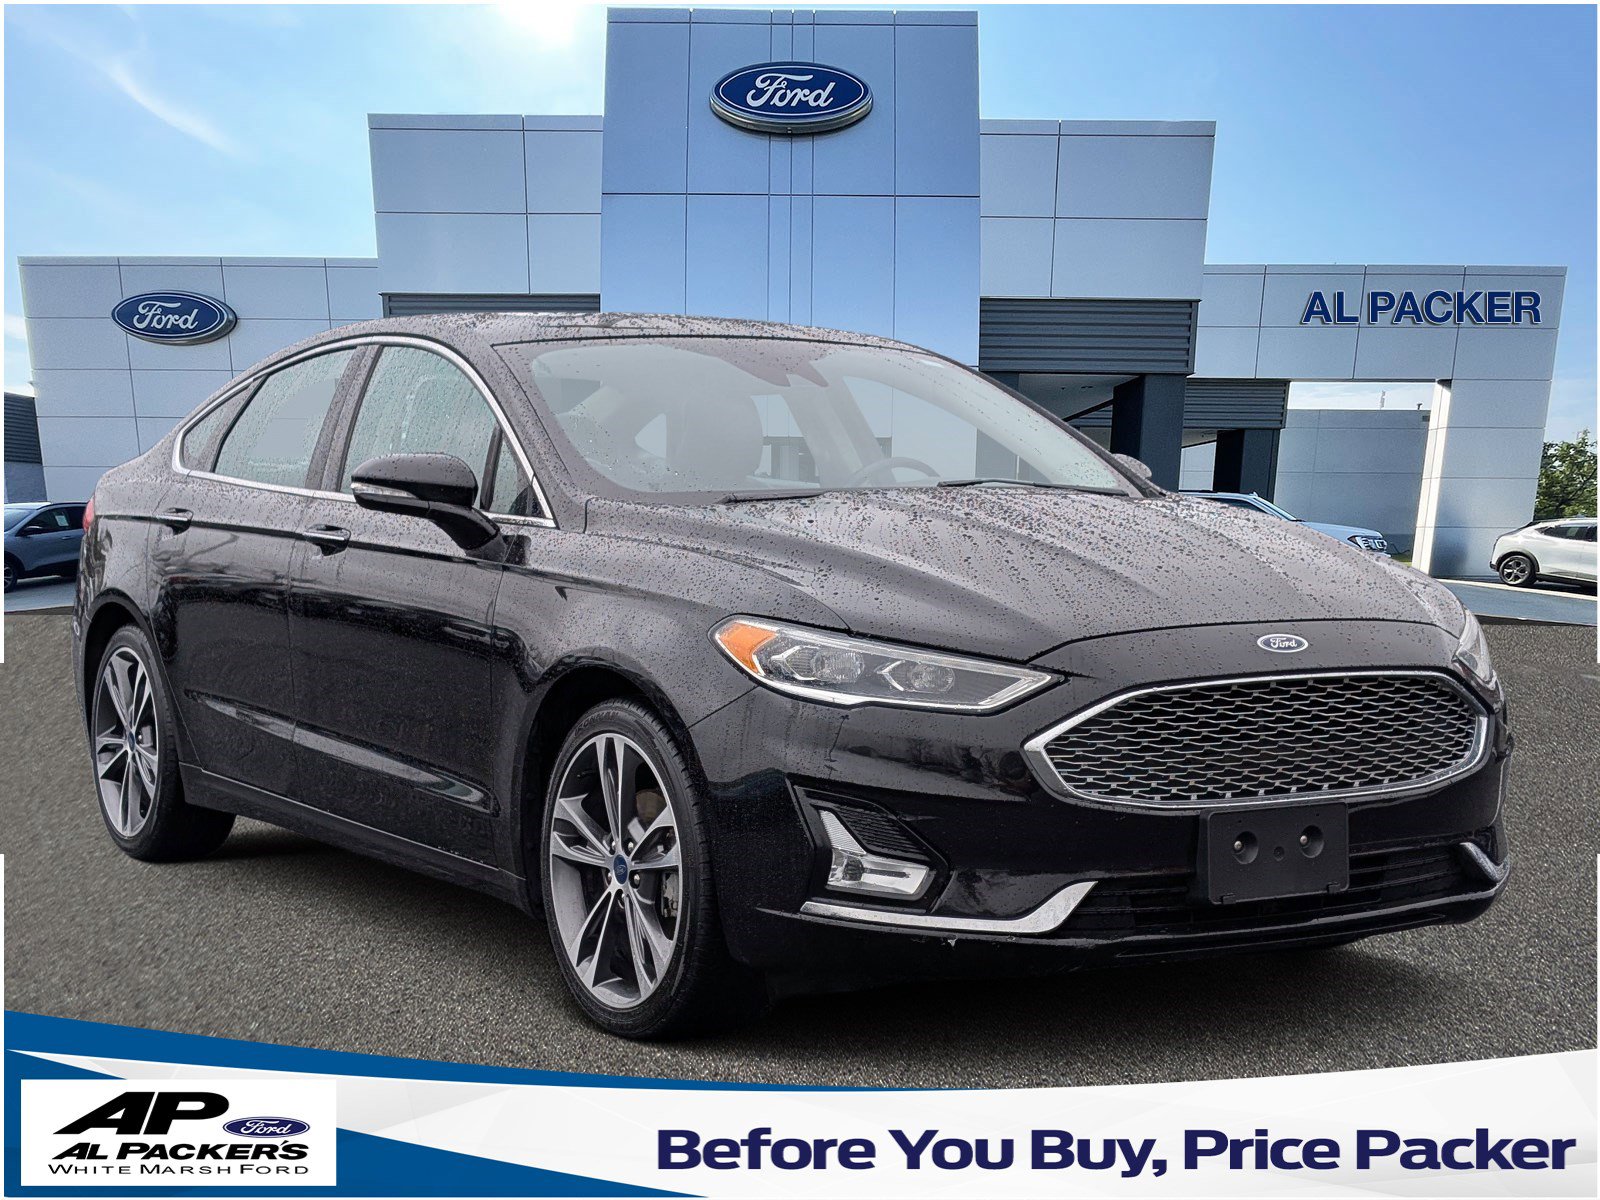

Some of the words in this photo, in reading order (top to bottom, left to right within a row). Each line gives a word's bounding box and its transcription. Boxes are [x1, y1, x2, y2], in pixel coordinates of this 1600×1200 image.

[746, 73, 836, 107] Ford
[133, 301, 198, 329] Ford
[1301, 290, 1360, 324] AL
[1368, 289, 1542, 325] PACKER
[1270, 637, 1298, 649] Ford
